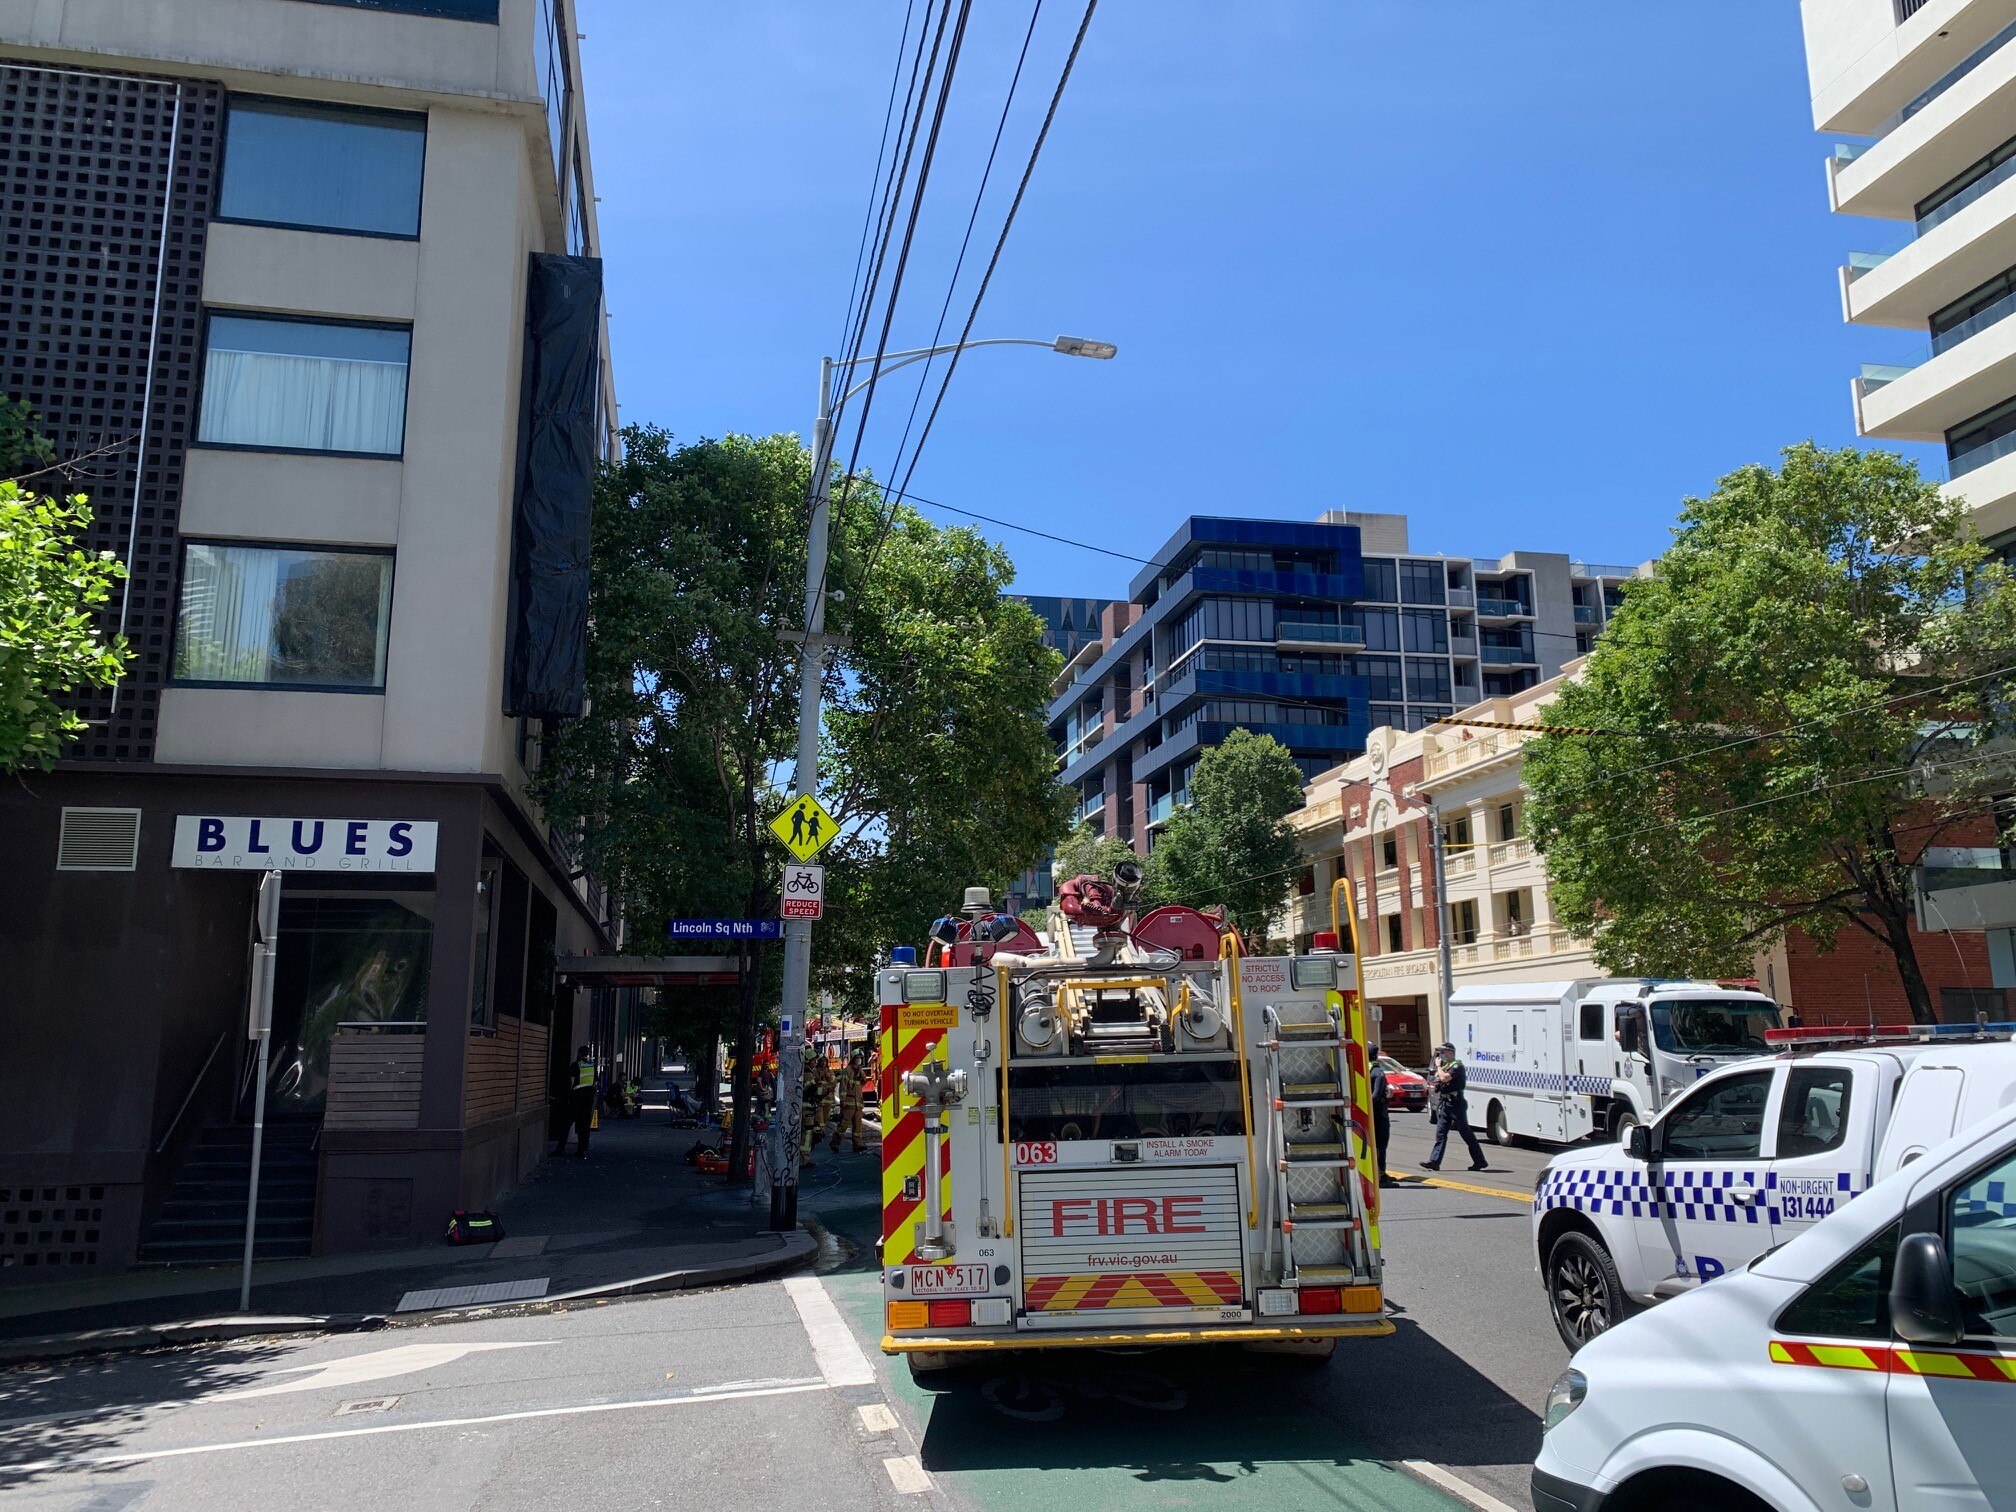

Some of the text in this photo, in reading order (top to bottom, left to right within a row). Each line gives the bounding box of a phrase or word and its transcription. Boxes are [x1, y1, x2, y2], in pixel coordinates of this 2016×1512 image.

[197, 818, 413, 857] BLUES
[194, 854, 413, 871] BAR AND GRILL
[786, 900, 818, 908] REDUCE
[673, 922, 753, 936] Lincoln Sq Nth
[1246, 964, 1280, 972] STRICTLY
[1256, 974, 1286, 982] ACCESS
[1476, 1052, 1500, 1062] Police
[1146, 1140, 1176, 1148] INSTALL
[1186, 1140, 1214, 1148] SMOKE
[1016, 1142, 1057, 1164] 063
[1154, 1150, 1182, 1158] ALARM
[1780, 1180, 1834, 1195] NON-URGENT
[1052, 1196, 1206, 1237] FIRE
[978, 1248, 995, 1257] 063
[1087, 1254, 1178, 1268] frv.vic.gov.au
[914, 1268, 984, 1288] MCN 517
